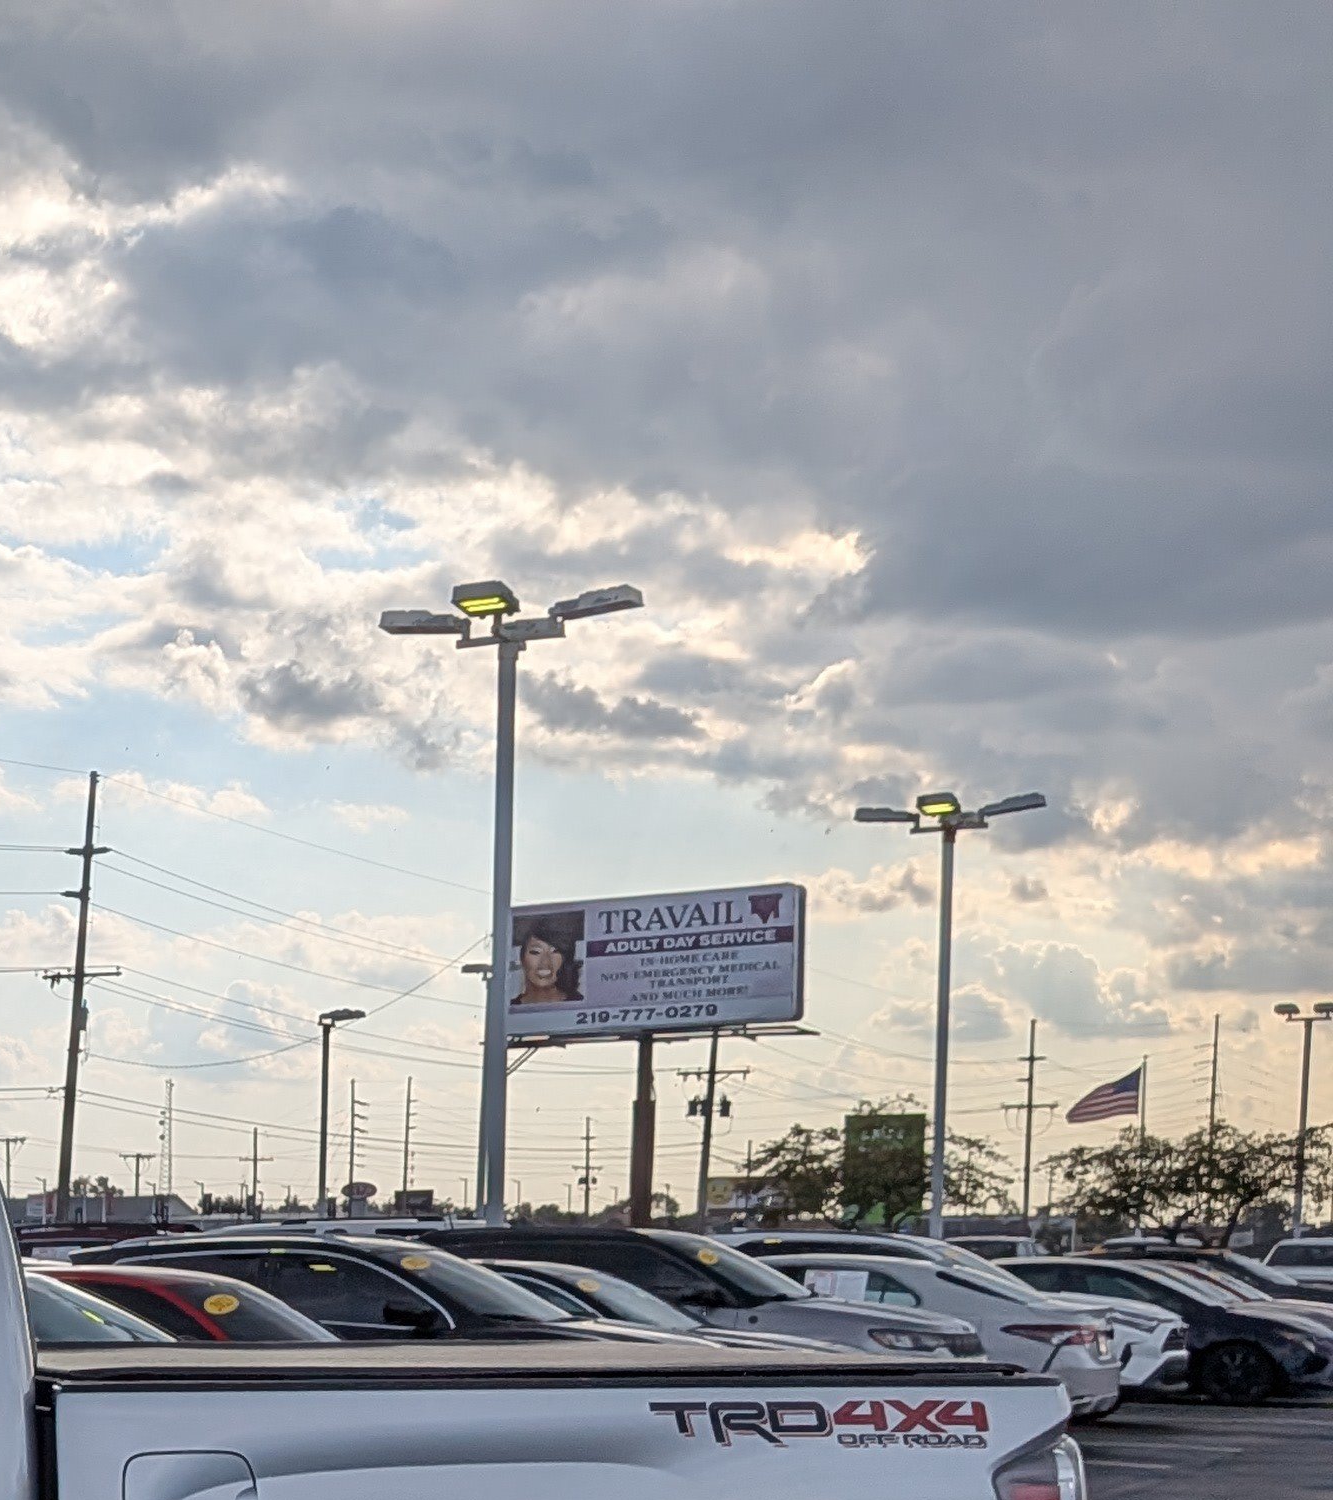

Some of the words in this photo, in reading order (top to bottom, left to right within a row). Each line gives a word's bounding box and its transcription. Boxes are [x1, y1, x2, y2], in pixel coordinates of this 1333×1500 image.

[598, 902, 743, 934] TRAVAIL
[604, 938, 660, 954] ADULT
[663, 935, 696, 949] DAY
[699, 929, 777, 946] SERVICE
[719, 960, 780, 973] MEDICAL
[650, 975, 729, 989] TRANSPORT
[631, 991, 659, 1002] AND
[662, 988, 703, 999] MUCH
[836, 1433, 898, 1449] OFF
[902, 1433, 987, 1449] ROAD
